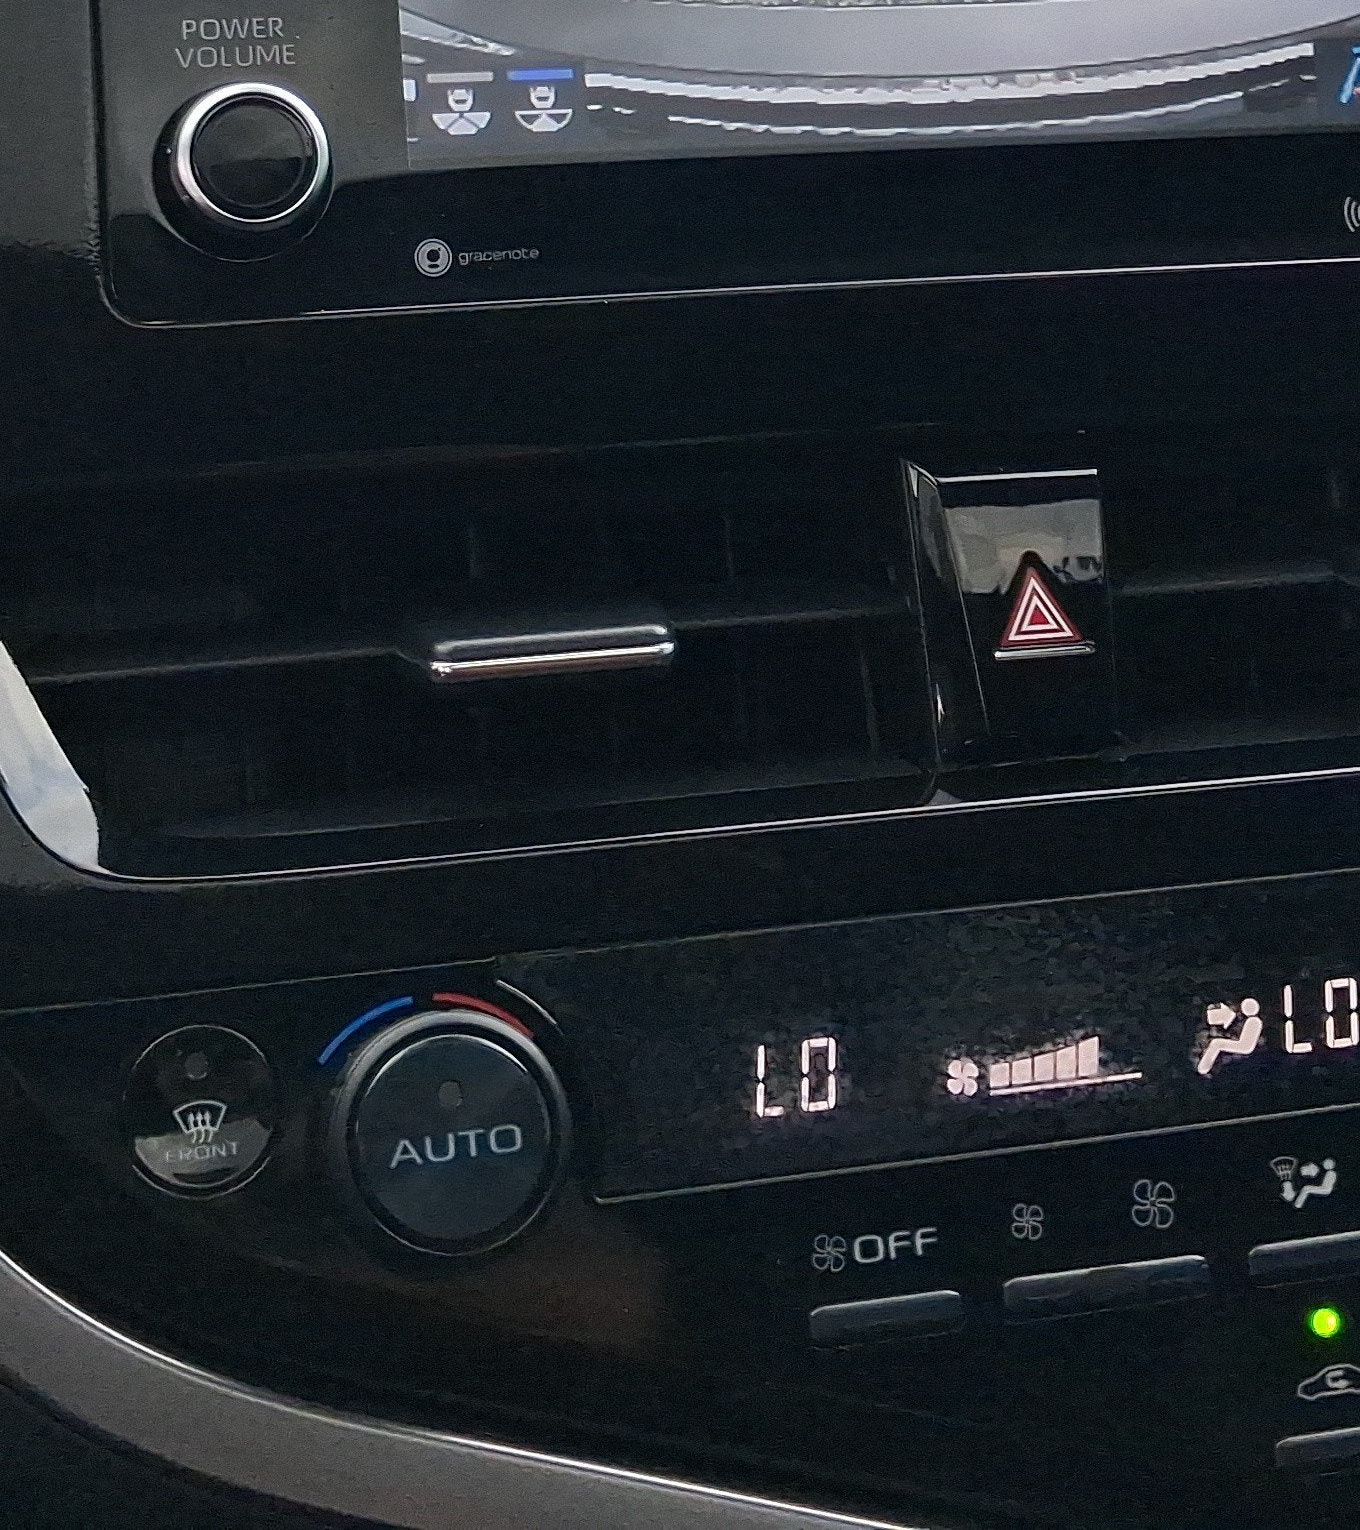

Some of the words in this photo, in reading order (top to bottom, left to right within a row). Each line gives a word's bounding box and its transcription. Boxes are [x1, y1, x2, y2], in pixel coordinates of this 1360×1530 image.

[180, 17, 284, 42] POWER
[175, 44, 296, 70] VOLUME
[457, 246, 540, 266] gracenote
[1283, 976, 1360, 1054] LO
[756, 1036, 837, 1118] LO
[390, 1123, 523, 1170] AUTO
[852, 1227, 939, 1265] OFF
